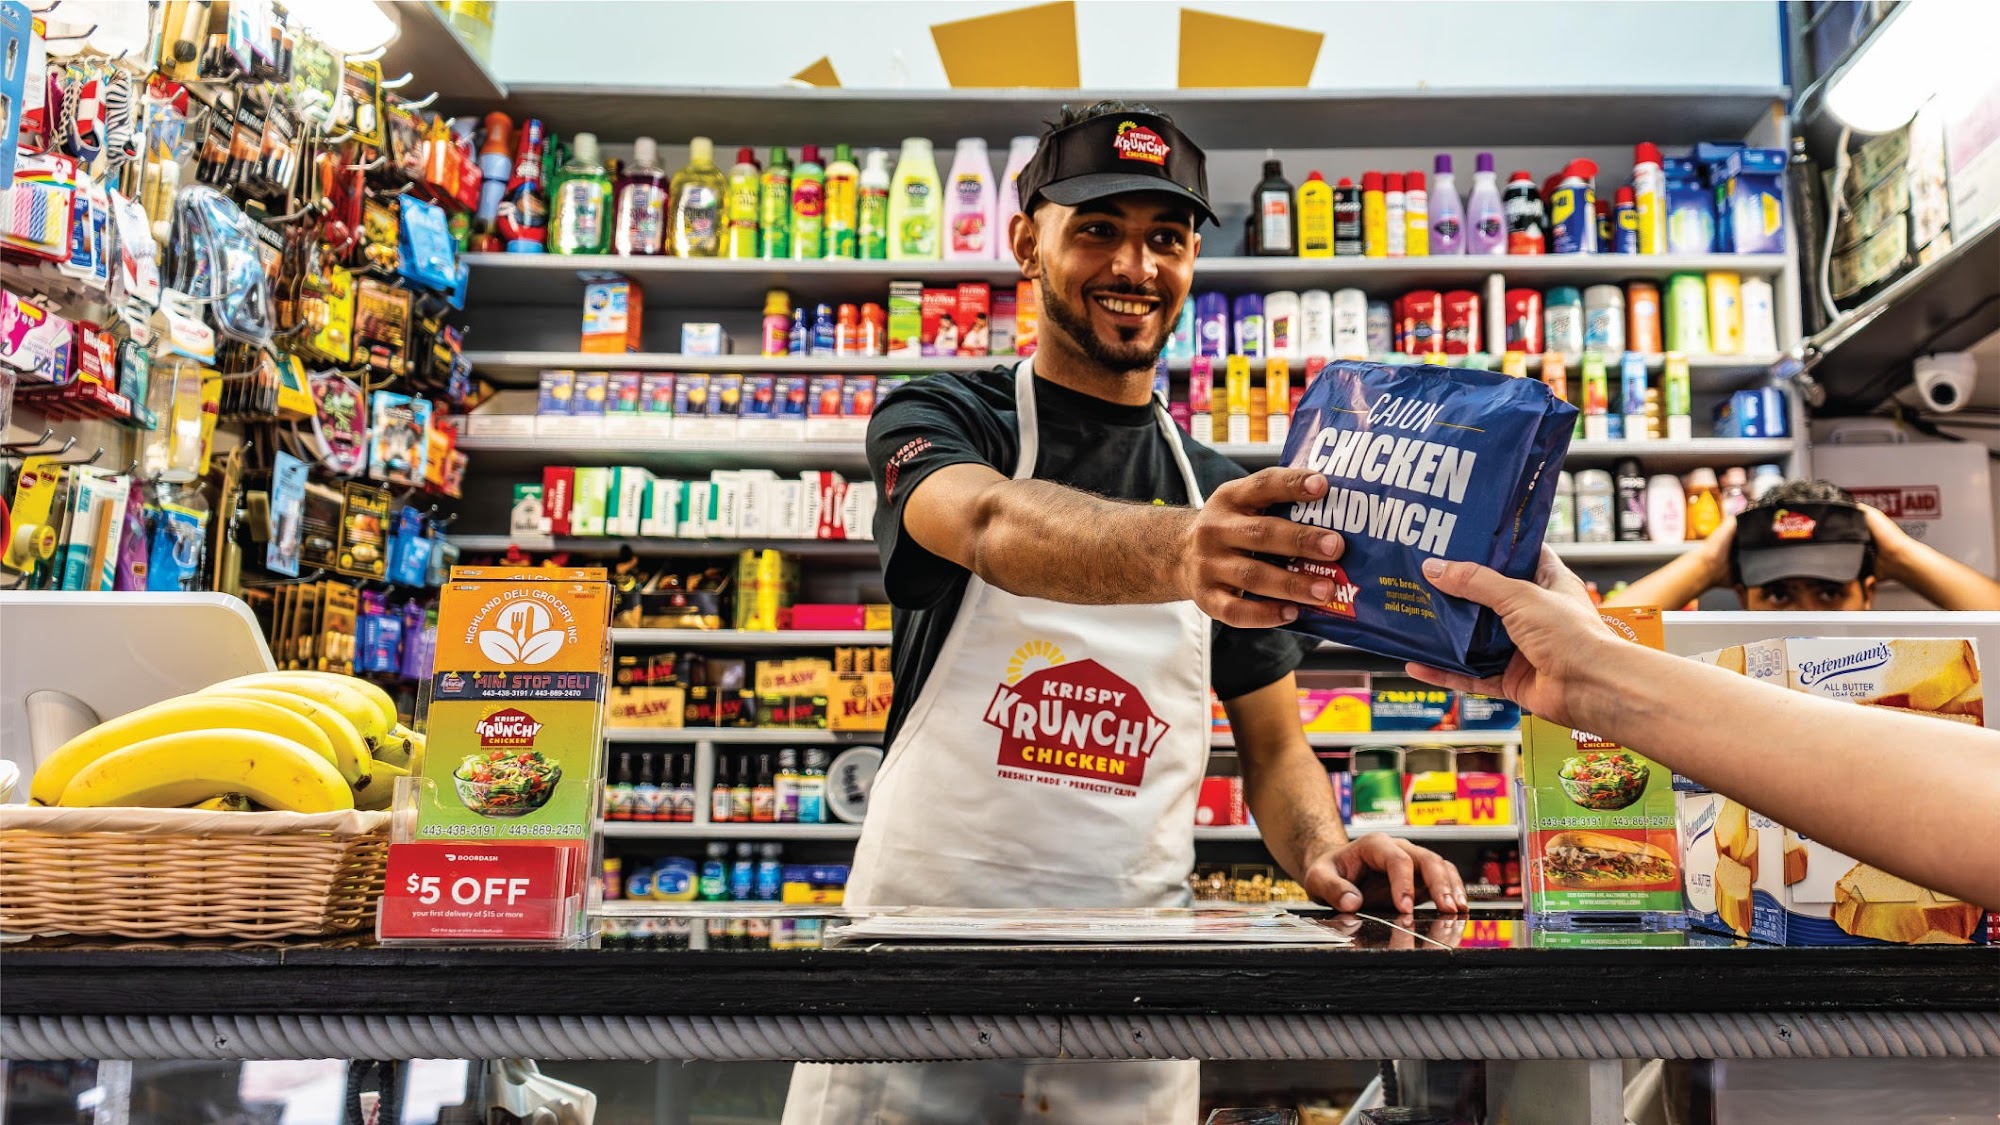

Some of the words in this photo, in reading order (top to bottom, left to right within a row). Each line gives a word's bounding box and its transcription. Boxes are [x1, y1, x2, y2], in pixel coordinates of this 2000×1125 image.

[1115, 135, 1170, 156] KRUNCHY
[1130, 132, 1156, 142] KRISPY
[1367, 393, 1444, 433] CAJUN
[903, 441, 932, 462] CAJUN
[1308, 426, 1477, 504] CHICKEN
[1905, 494, 1935, 510] AID
[1304, 562, 1337, 578] KRISPY
[464, 597, 501, 644] HIGHLAND
[504, 589, 529, 600] DELI
[532, 589, 575, 624] GROCERY
[568, 626, 578, 644] INC
[1385, 603, 1400, 611] mild
[1401, 604, 1421, 616] Cajun
[1600, 614, 1639, 642] GROCERY
[1799, 642, 1891, 685] Entenmann's
[475, 676, 507, 688] MINI
[512, 675, 552, 689] STOP
[557, 675, 590, 689] DELI
[775, 671, 817, 687] RAW
[1823, 683, 1839, 691] ALL
[1843, 683, 1874, 691] BUTTER
[1042, 680, 1127, 707] KRISPY
[624, 700, 671, 718] RAW
[844, 694, 892, 716] RAW
[476, 721, 543, 738] KRUNCHY
[987, 688, 1166, 757] KRUNCHY
[1022, 746, 1126, 775] CHICKEN
[998, 770, 1034, 782] FRESHLY
[1037, 777, 1060, 786] MADE
[1069, 781, 1112, 793] PERFECTLY
[1114, 787, 1137, 797] CAJUN
[422, 824, 495, 836] 443-438-3191
[508, 825, 582, 836] 443-869-2470
[406, 873, 441, 904] $5
[451, 876, 531, 905] OFF
[445, 910, 473, 919] delivery
